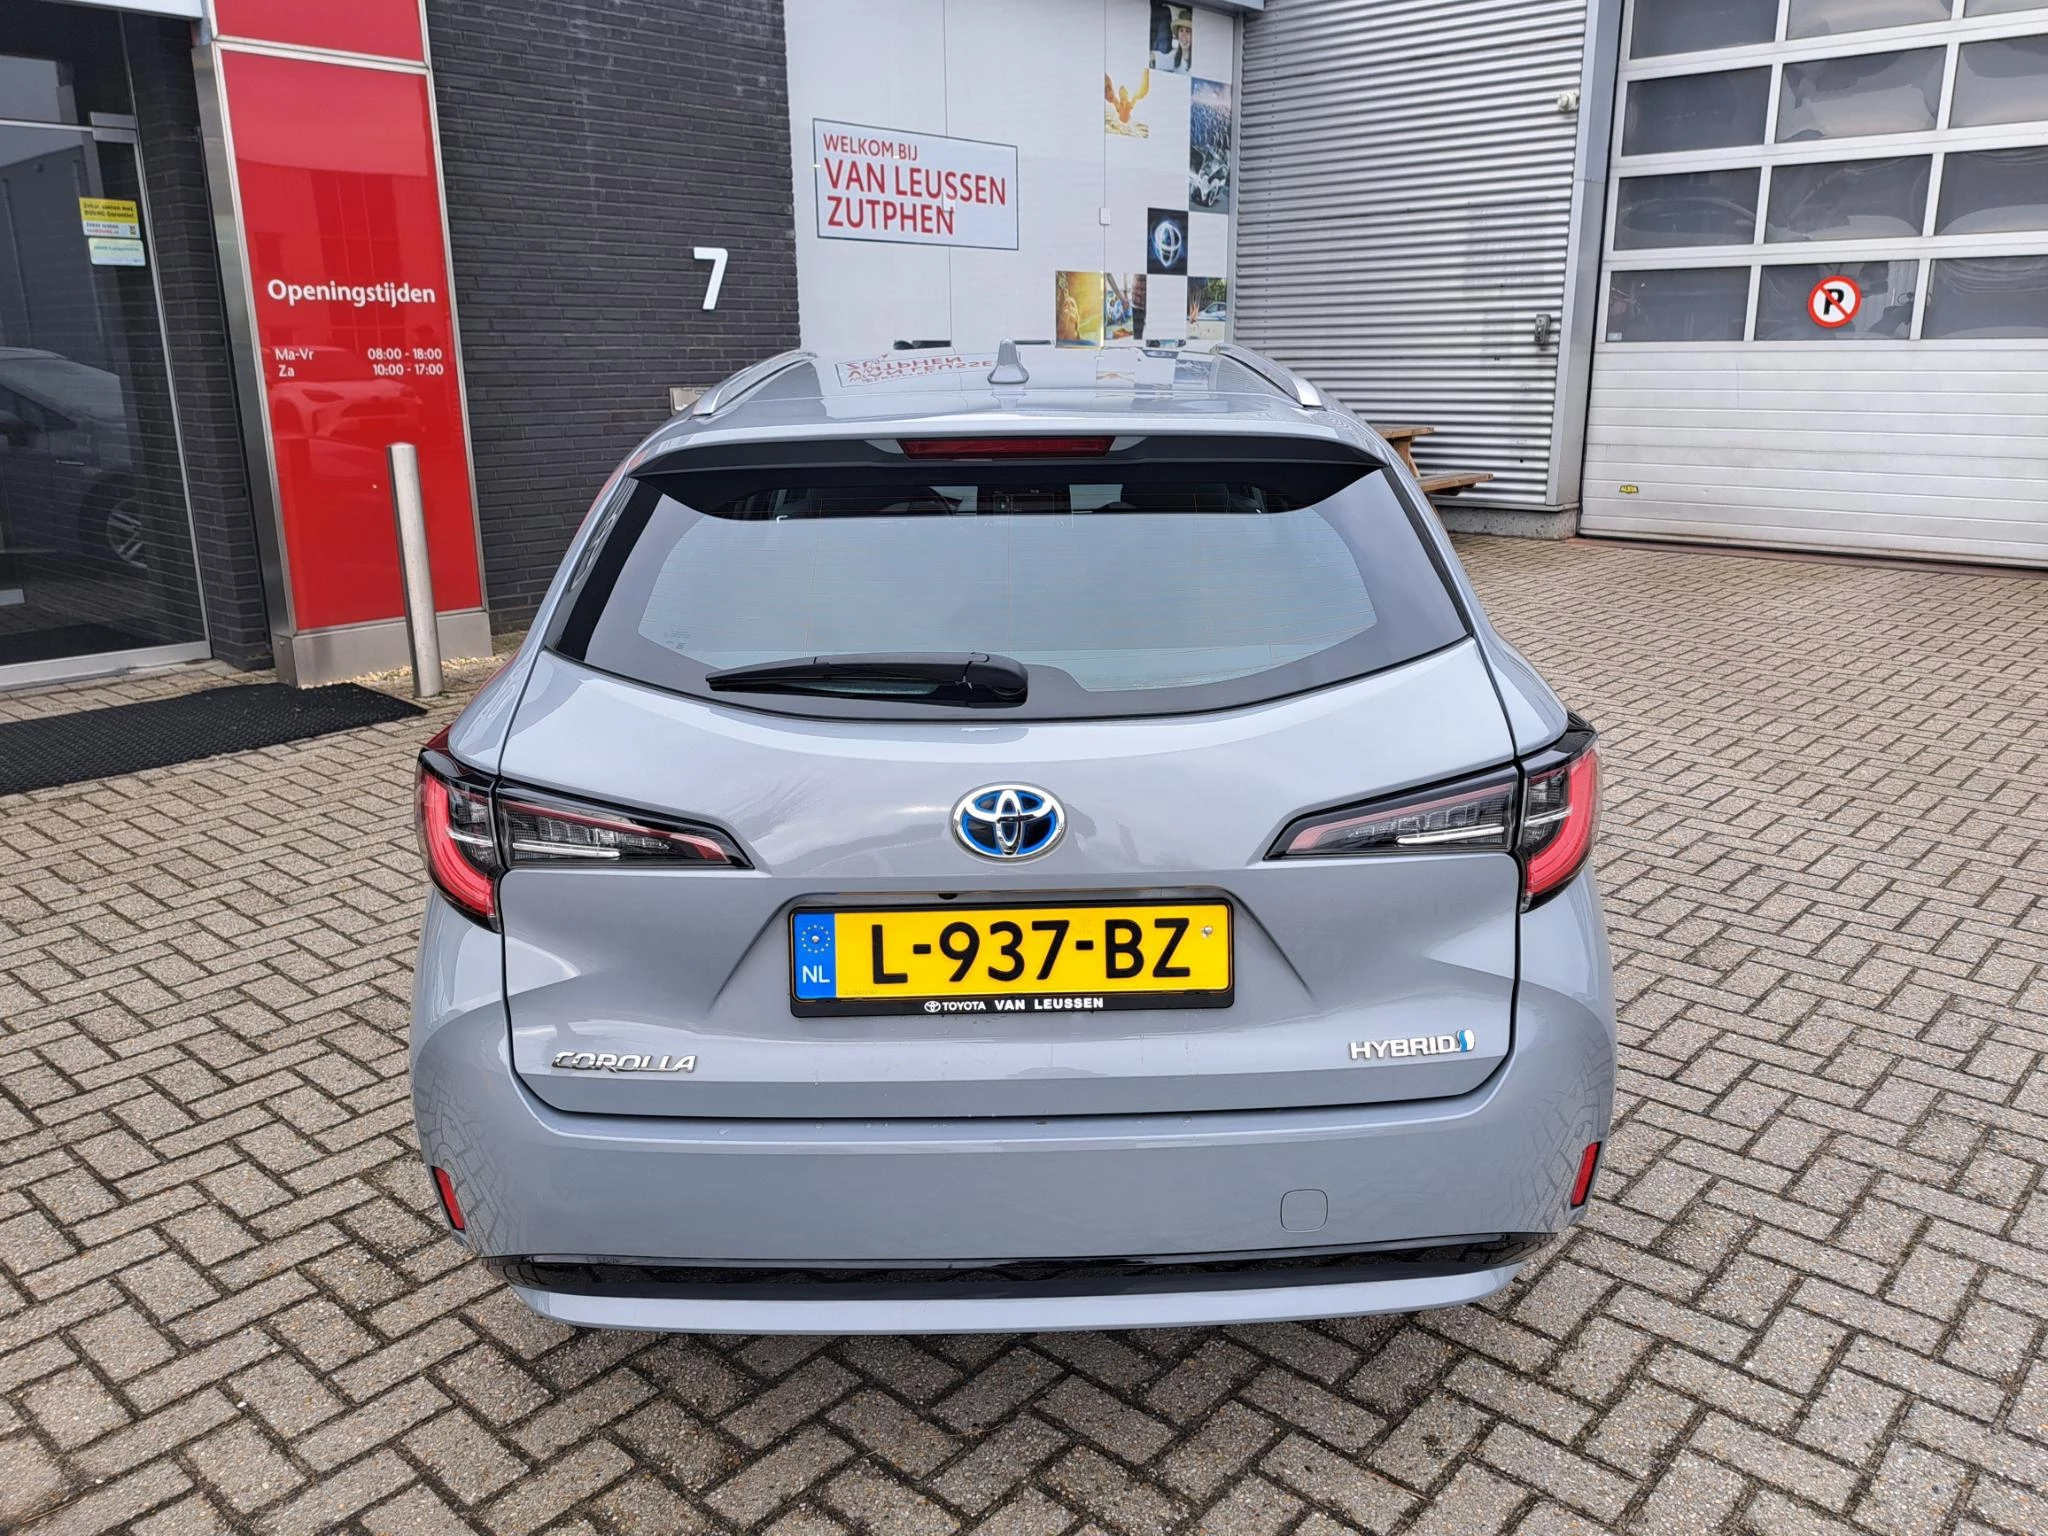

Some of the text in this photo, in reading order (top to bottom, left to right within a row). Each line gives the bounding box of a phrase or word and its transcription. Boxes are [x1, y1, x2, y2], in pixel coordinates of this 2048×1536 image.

[823, 133, 918, 161] WELKOM BIJ
[824, 157, 1006, 206] VAN LEUSSEN
[827, 196, 954, 235] ZUTPHEN
[693, 247, 729, 310] 7
[267, 279, 436, 308] Openingstijden
[275, 348, 314, 361] Ma-Vr
[367, 347, 402, 360] 08:00
[413, 347, 442, 360] 18:00
[278, 364, 295, 377] Za
[373, 363, 404, 376] 10:00
[414, 363, 444, 376] 17:00
[871, 917, 1191, 985] L-937-BZ
[802, 965, 830, 984] NL
[942, 997, 1104, 1012] TOYOTA VAN LEUSSEN
[1349, 1035, 1461, 1061] HYBRID
[552, 1051, 698, 1073] COROLLA
